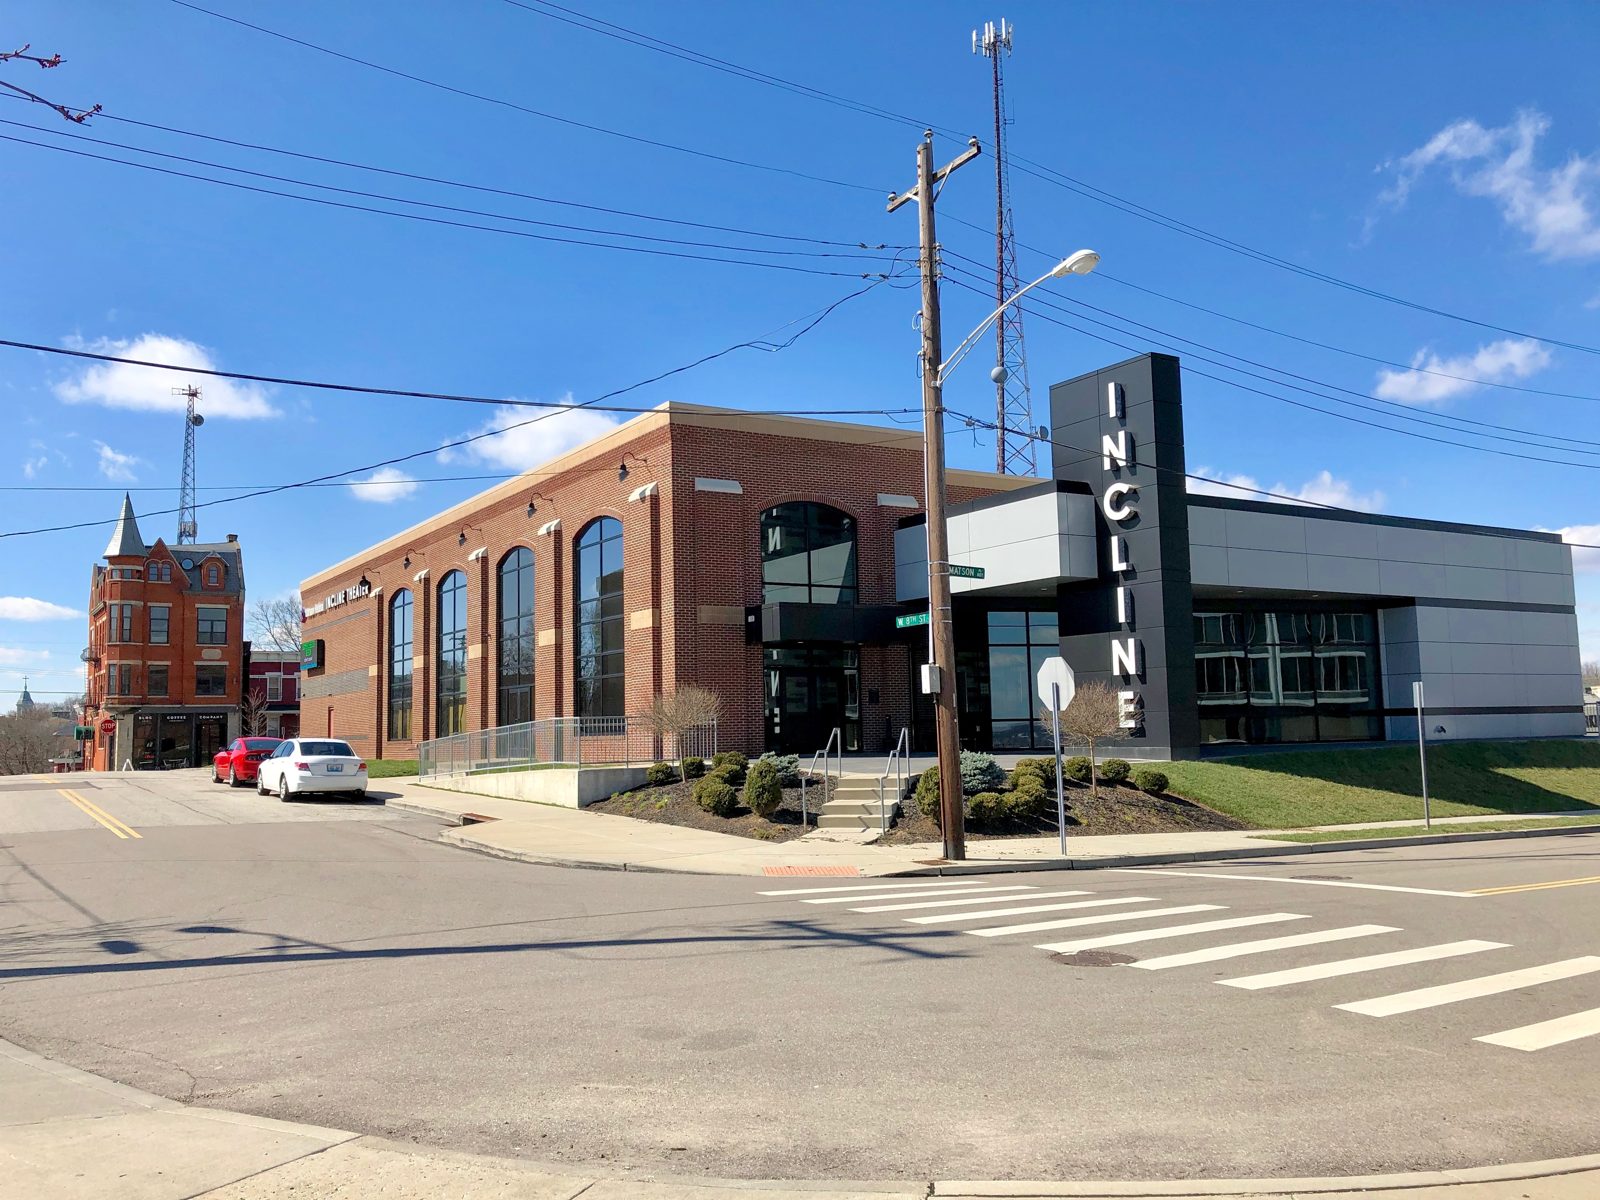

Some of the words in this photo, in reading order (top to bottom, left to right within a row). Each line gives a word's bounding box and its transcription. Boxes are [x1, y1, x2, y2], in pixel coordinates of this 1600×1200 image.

[1102, 382, 1137, 728] INCLINE
[949, 566, 975, 577] MATSON
[897, 617, 904, 626] W
[905, 615, 917, 625] 8TH
[101, 722, 116, 730] STOP
